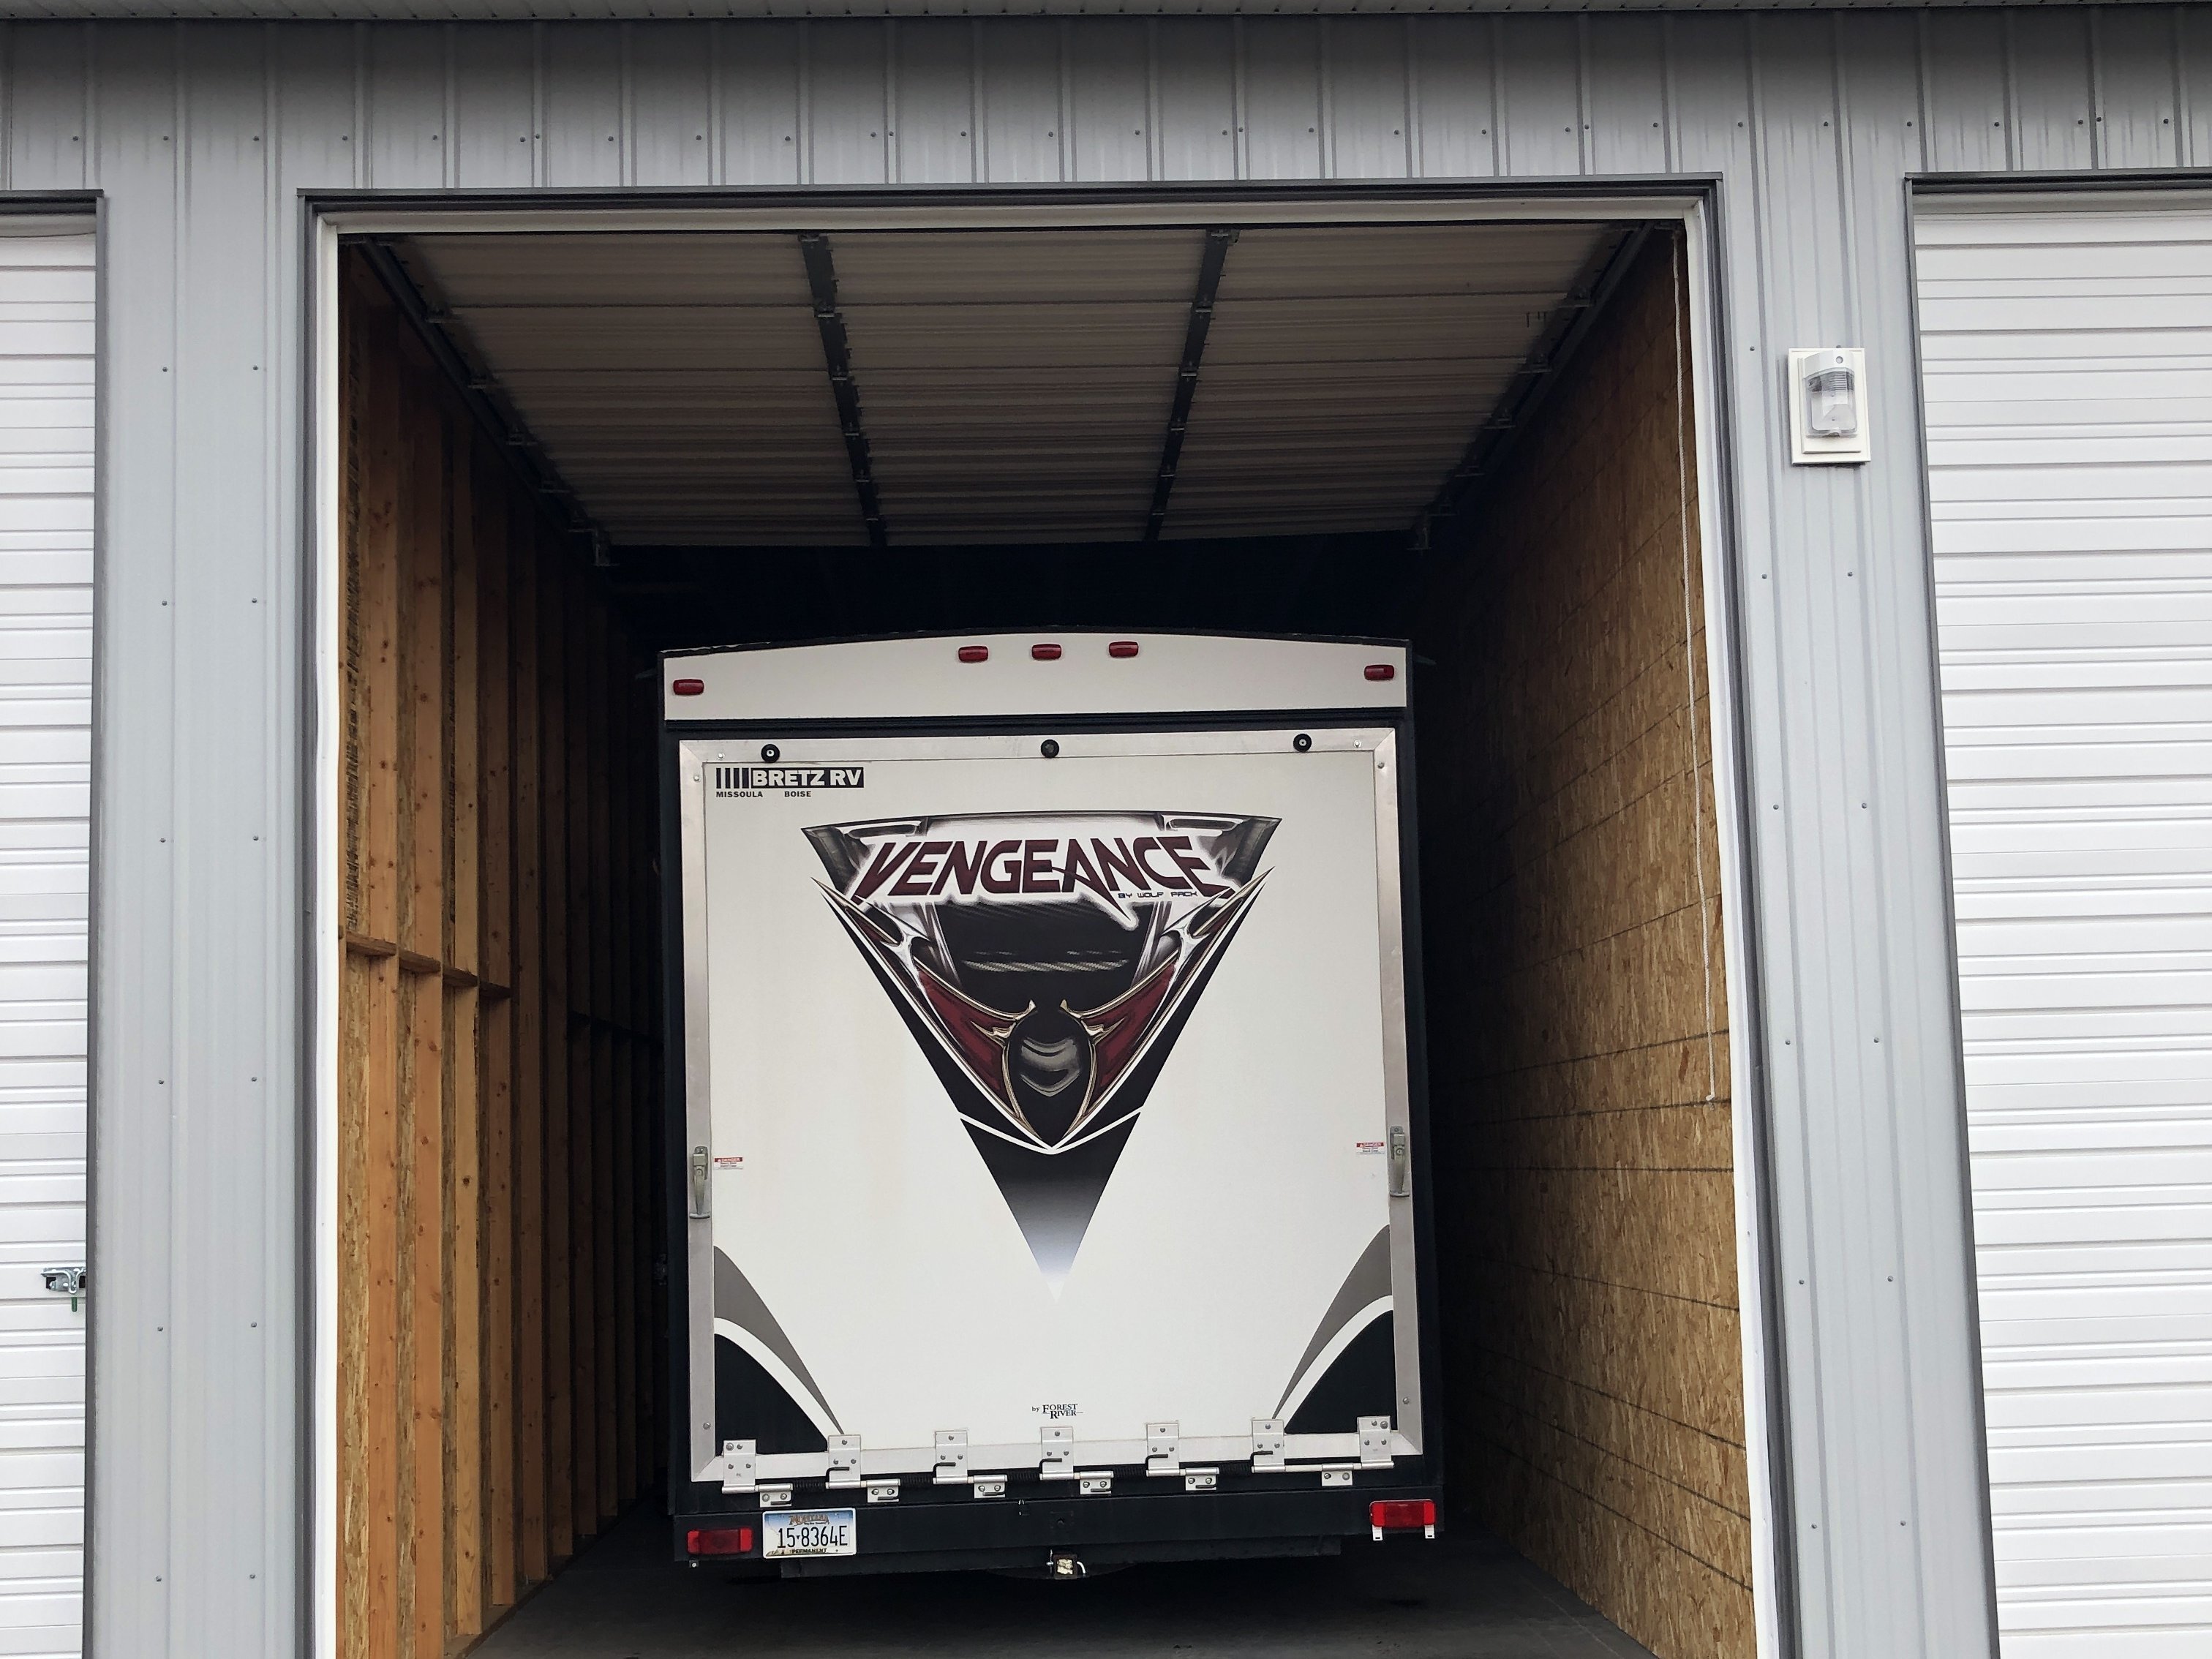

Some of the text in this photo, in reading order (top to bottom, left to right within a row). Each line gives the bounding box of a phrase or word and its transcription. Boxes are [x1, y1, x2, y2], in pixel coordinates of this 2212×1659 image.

[753, 769, 862, 786] BRETZ RV
[853, 836, 1236, 920] VENGEANCE
[1042, 1403, 1078, 1413] FOREST
[1050, 1410, 1077, 1420] RIVER
